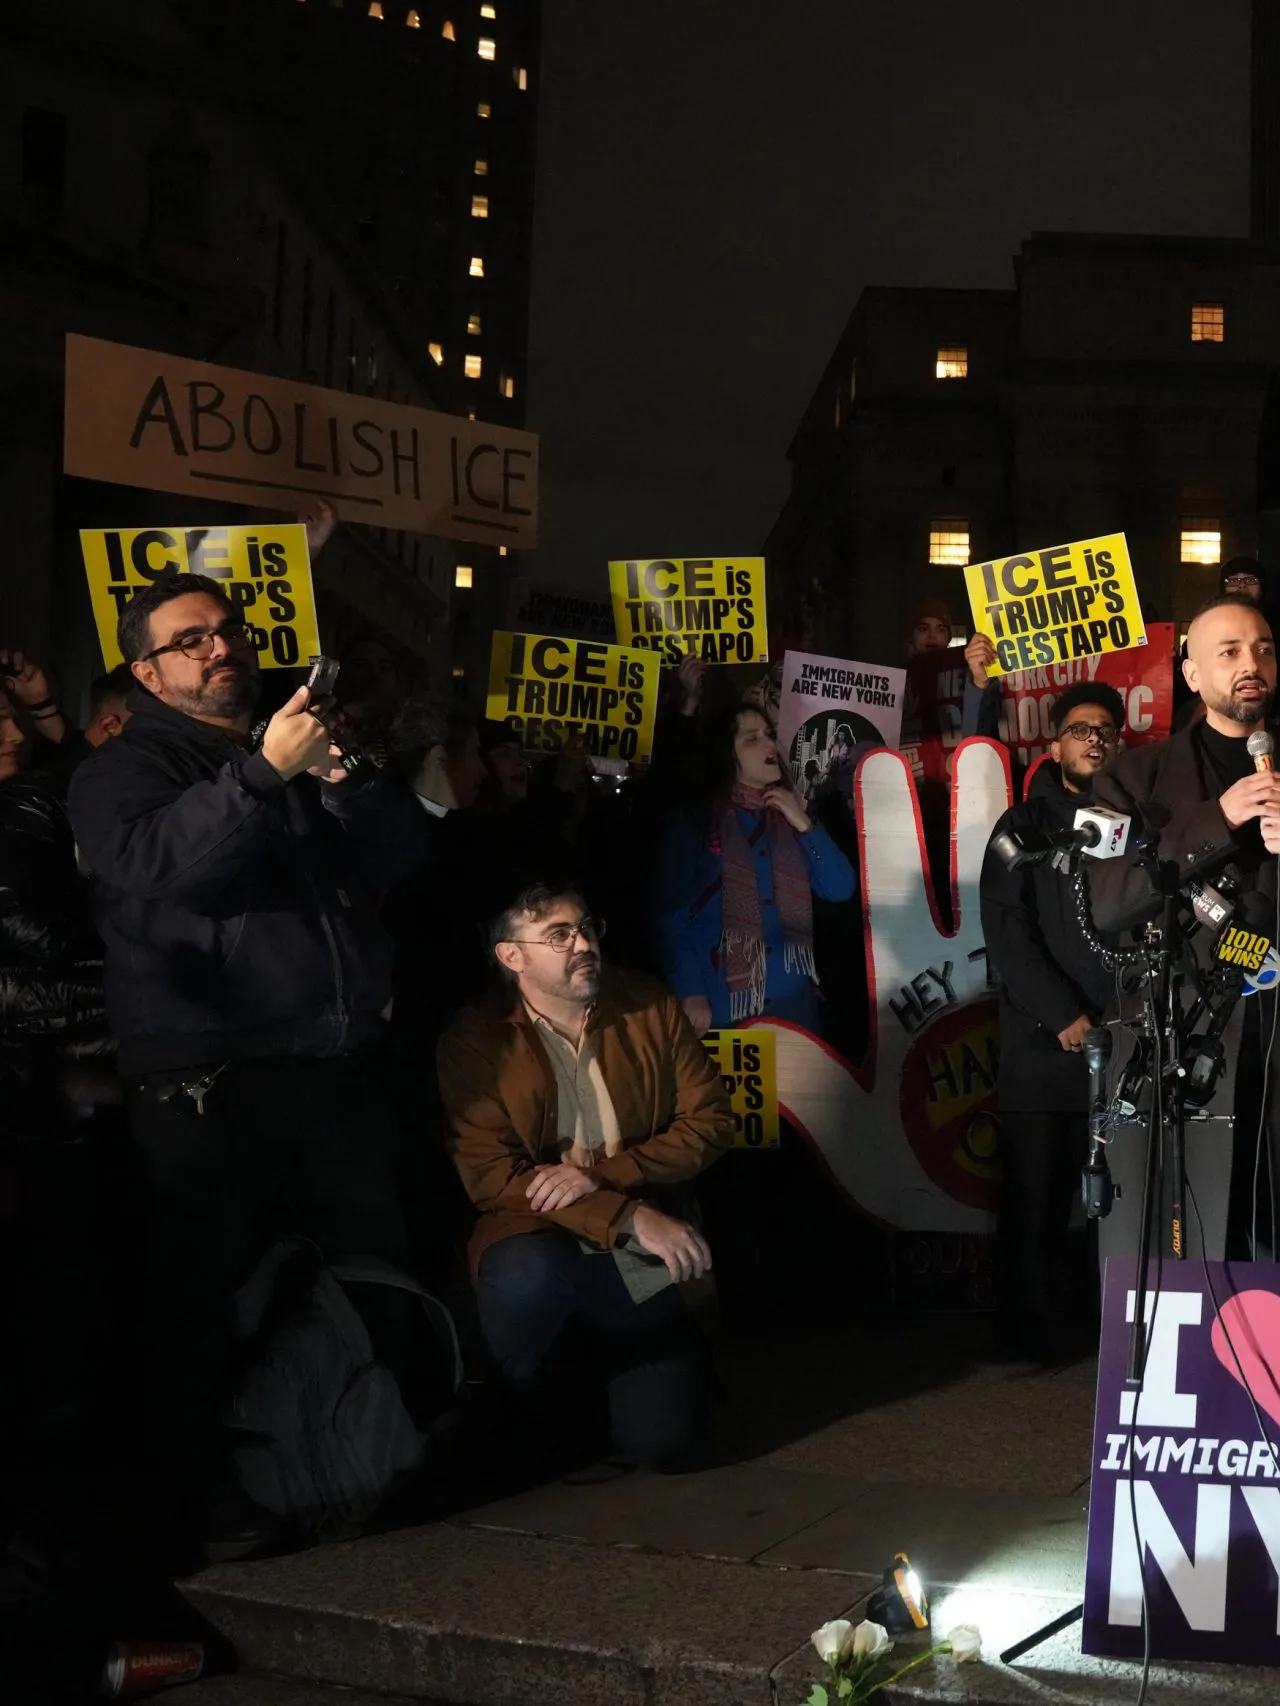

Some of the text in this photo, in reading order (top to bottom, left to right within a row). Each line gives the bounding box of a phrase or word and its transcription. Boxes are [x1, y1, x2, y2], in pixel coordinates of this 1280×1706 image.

[128, 375, 532, 516] ABOLISH ICE
[105, 530, 288, 581] ICE is
[982, 547, 1115, 602] ICE is
[108, 580, 296, 622] TP'S
[626, 560, 751, 599] ICE is
[625, 598, 754, 632] TRUMP'S
[985, 580, 1124, 638] TRUMP'S
[511, 635, 645, 689] ICE is
[996, 616, 1130, 672] GESTAPO
[791, 679, 896, 708] ARE NEW YORK!
[801, 664, 890, 691] IMMIGRANTS
[937, 655, 1102, 698] NE ORK CITY
[506, 677, 643, 725] TRUMP'S
[1218, 943, 1263, 970] WINS
[1226, 927, 1270, 954] 1010
[889, 961, 957, 1033] HEY
[732, 1038, 760, 1072] is
[1119, 1290, 1203, 1428] I
